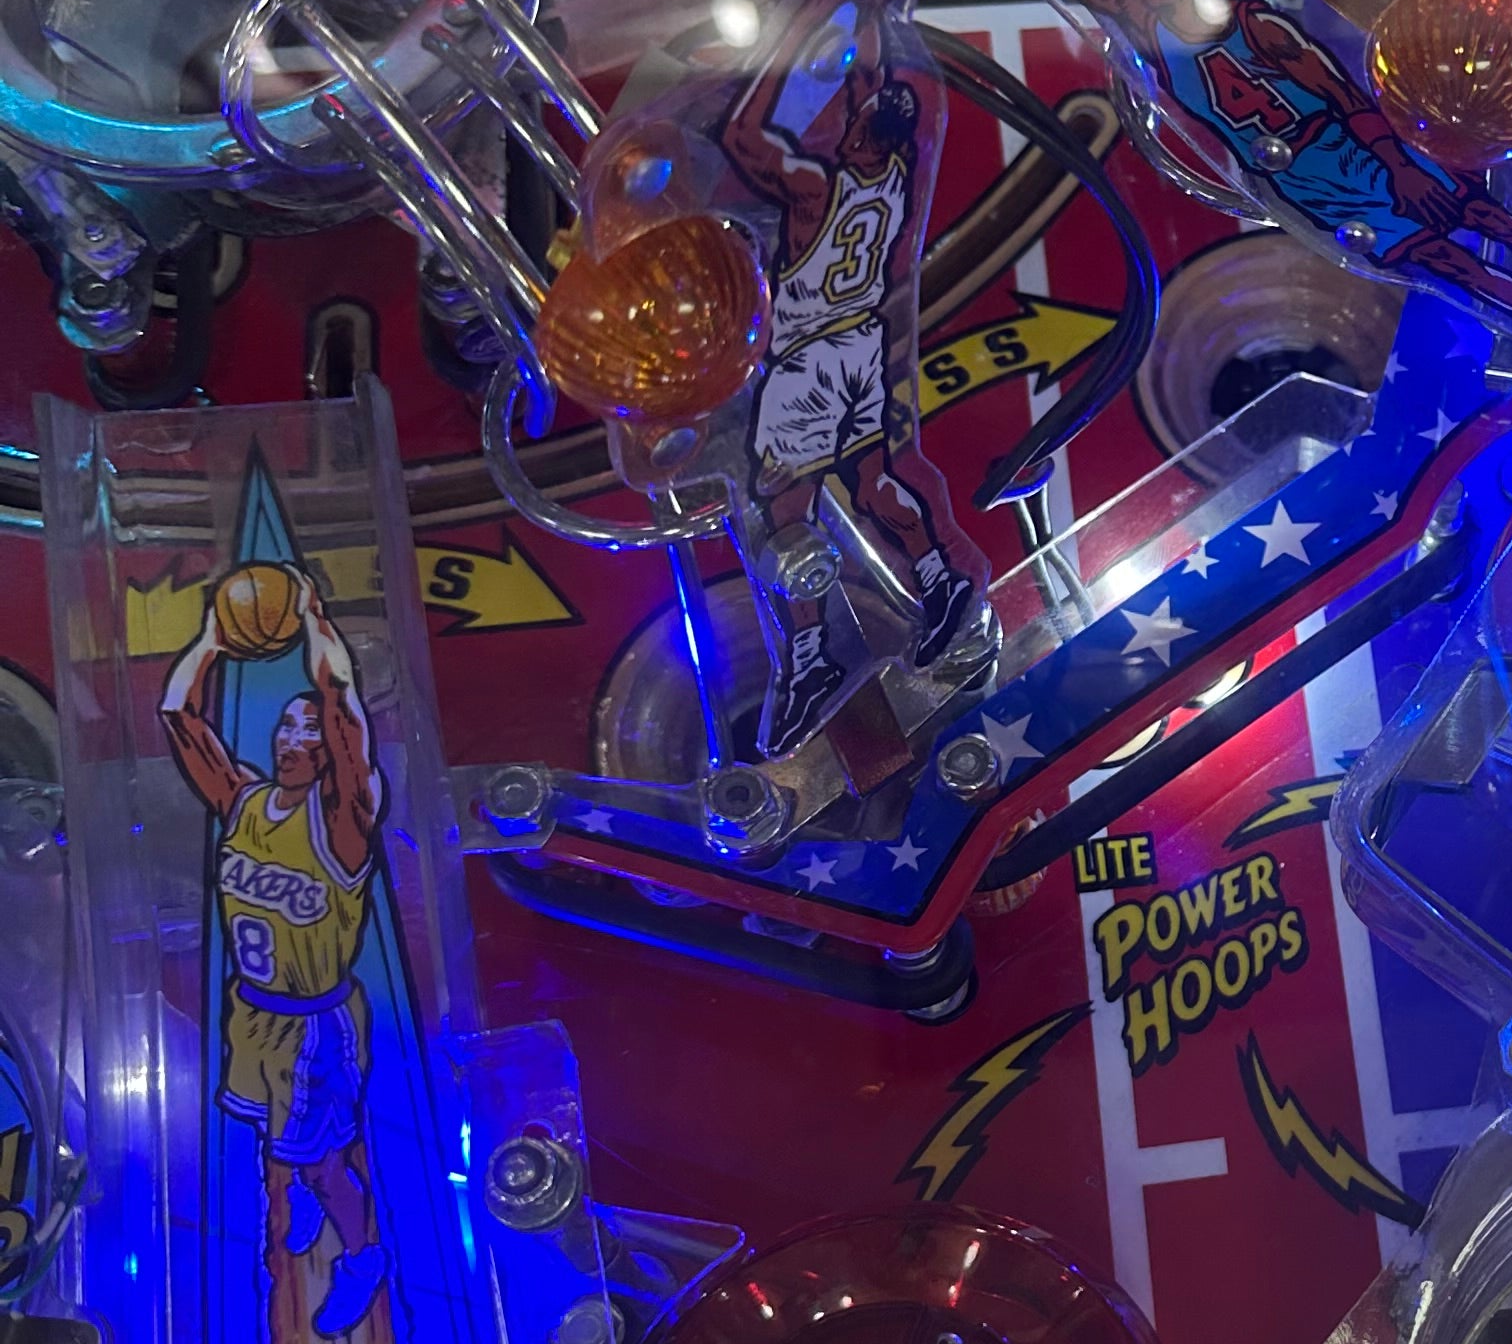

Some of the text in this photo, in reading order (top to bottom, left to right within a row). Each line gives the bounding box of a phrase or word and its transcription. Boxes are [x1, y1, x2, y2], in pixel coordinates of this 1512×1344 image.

[1197, 46, 1302, 137] 4
[822, 201, 892, 303] 3
[1075, 835, 1154, 887] LITE
[233, 915, 277, 984] 8
[1098, 855, 1278, 988] POWER
[1126, 909, 1303, 1063] HOOPS
